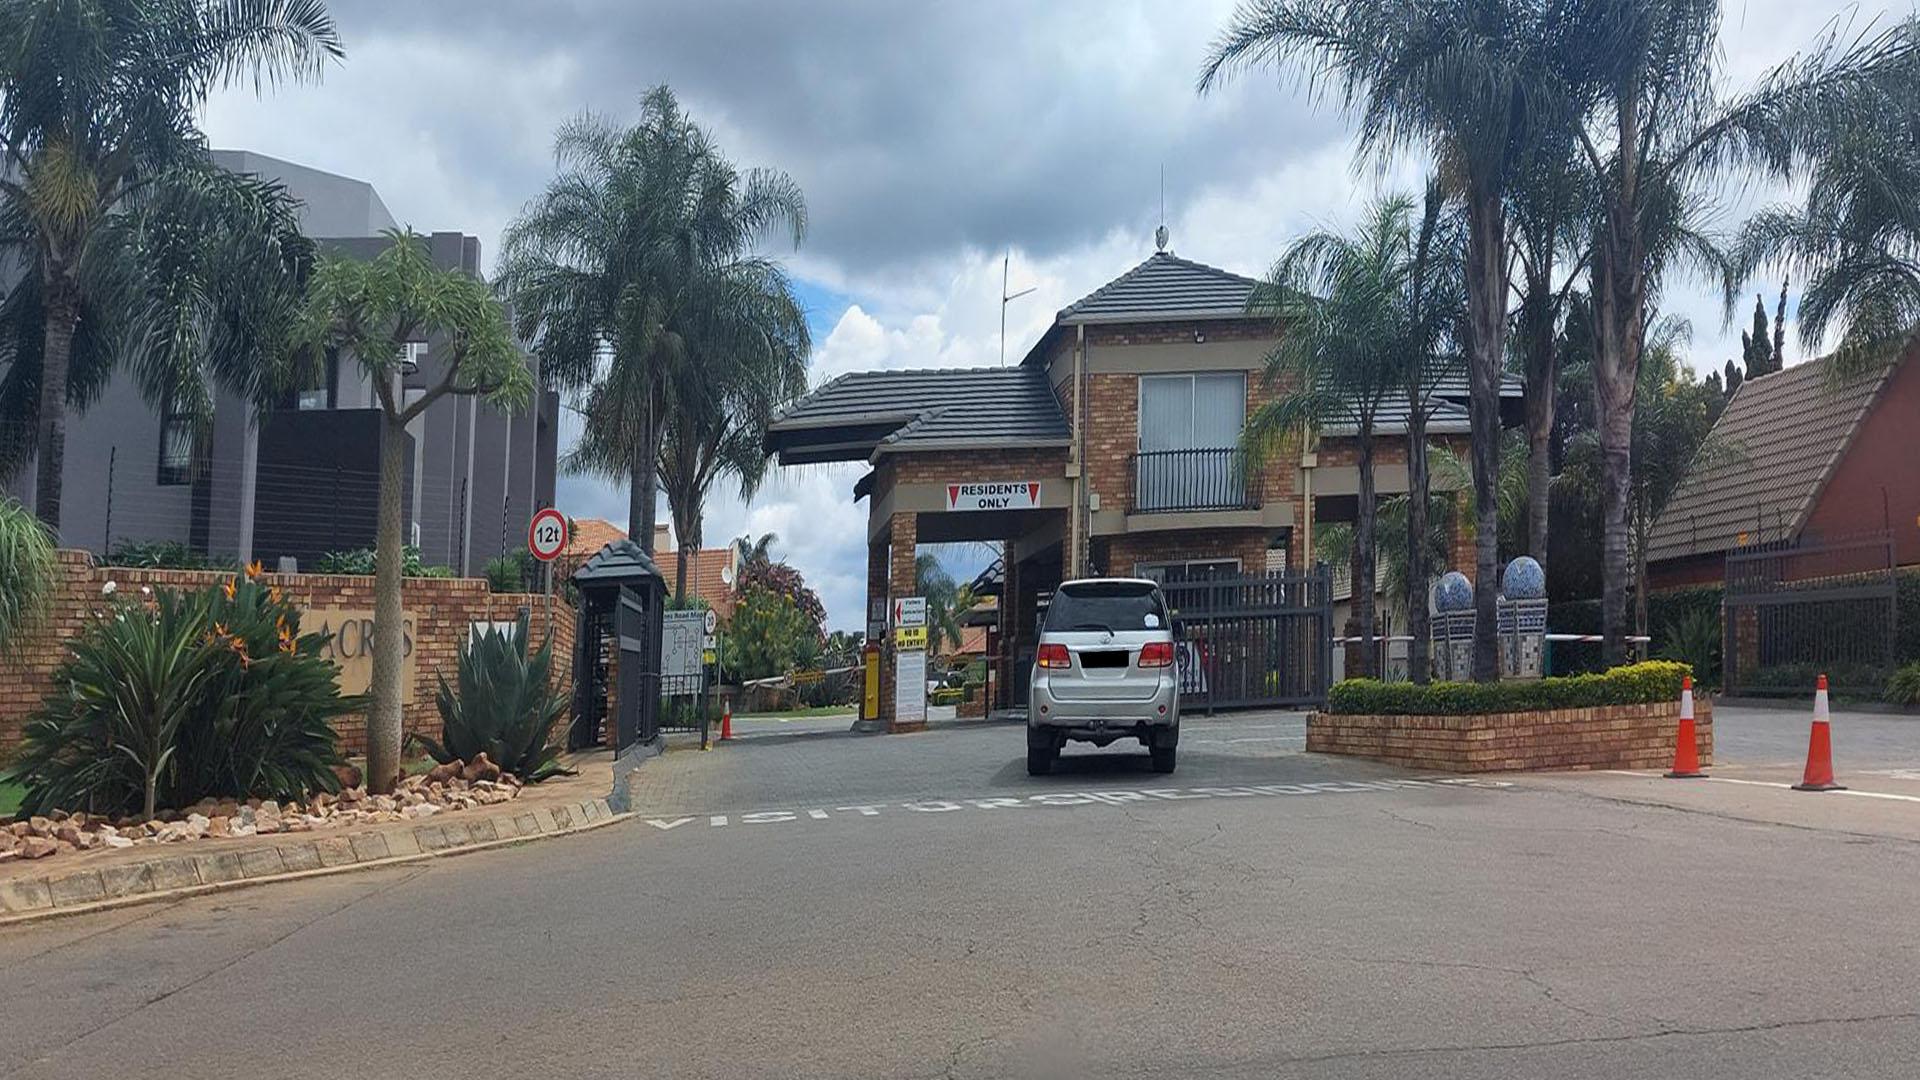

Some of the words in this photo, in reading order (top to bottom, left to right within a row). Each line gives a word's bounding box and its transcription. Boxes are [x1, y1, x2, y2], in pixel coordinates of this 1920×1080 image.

[961, 483, 1027, 496] RESIDENTS
[978, 498, 1009, 508] ONLY
[536, 526, 559, 543] 12t
[318, 619, 413, 658] ACRS
[904, 629, 912, 637] NO
[898, 640, 905, 648] NO
